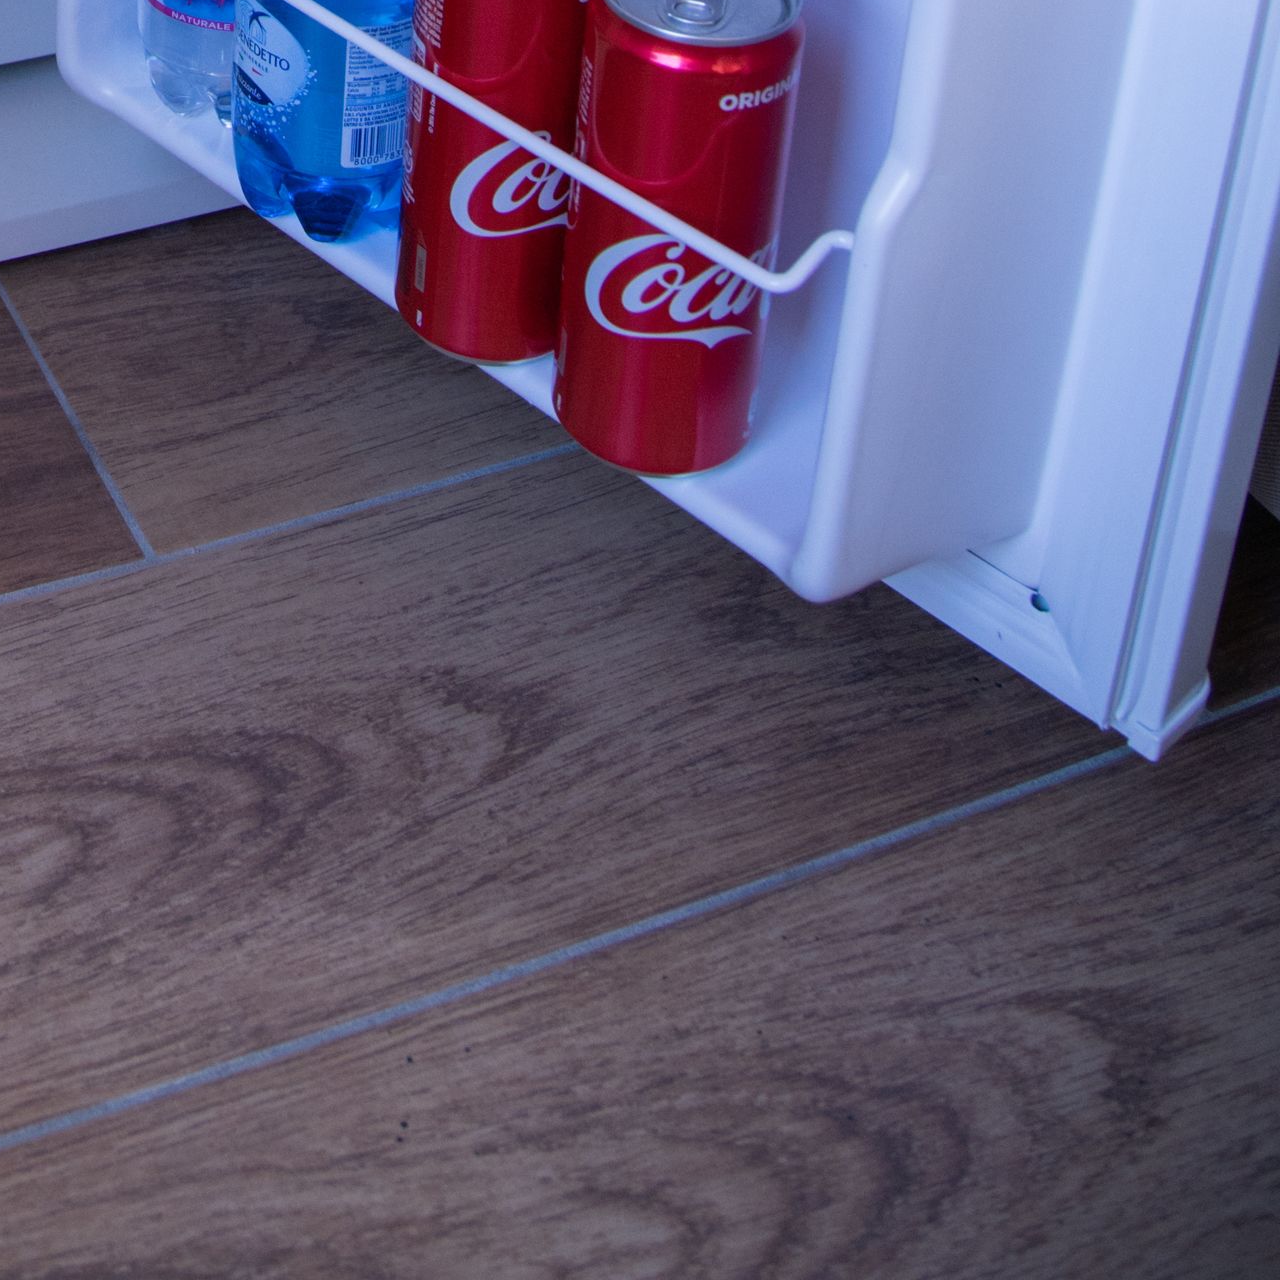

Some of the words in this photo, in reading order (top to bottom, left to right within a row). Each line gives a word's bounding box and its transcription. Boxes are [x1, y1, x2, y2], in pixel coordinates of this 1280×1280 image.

[171, 10, 232, 32] NATURALE
[238, 28, 291, 72] ENEDETTO
[718, 74, 794, 113] ORIGIN
[449, 130, 573, 238] Coc
